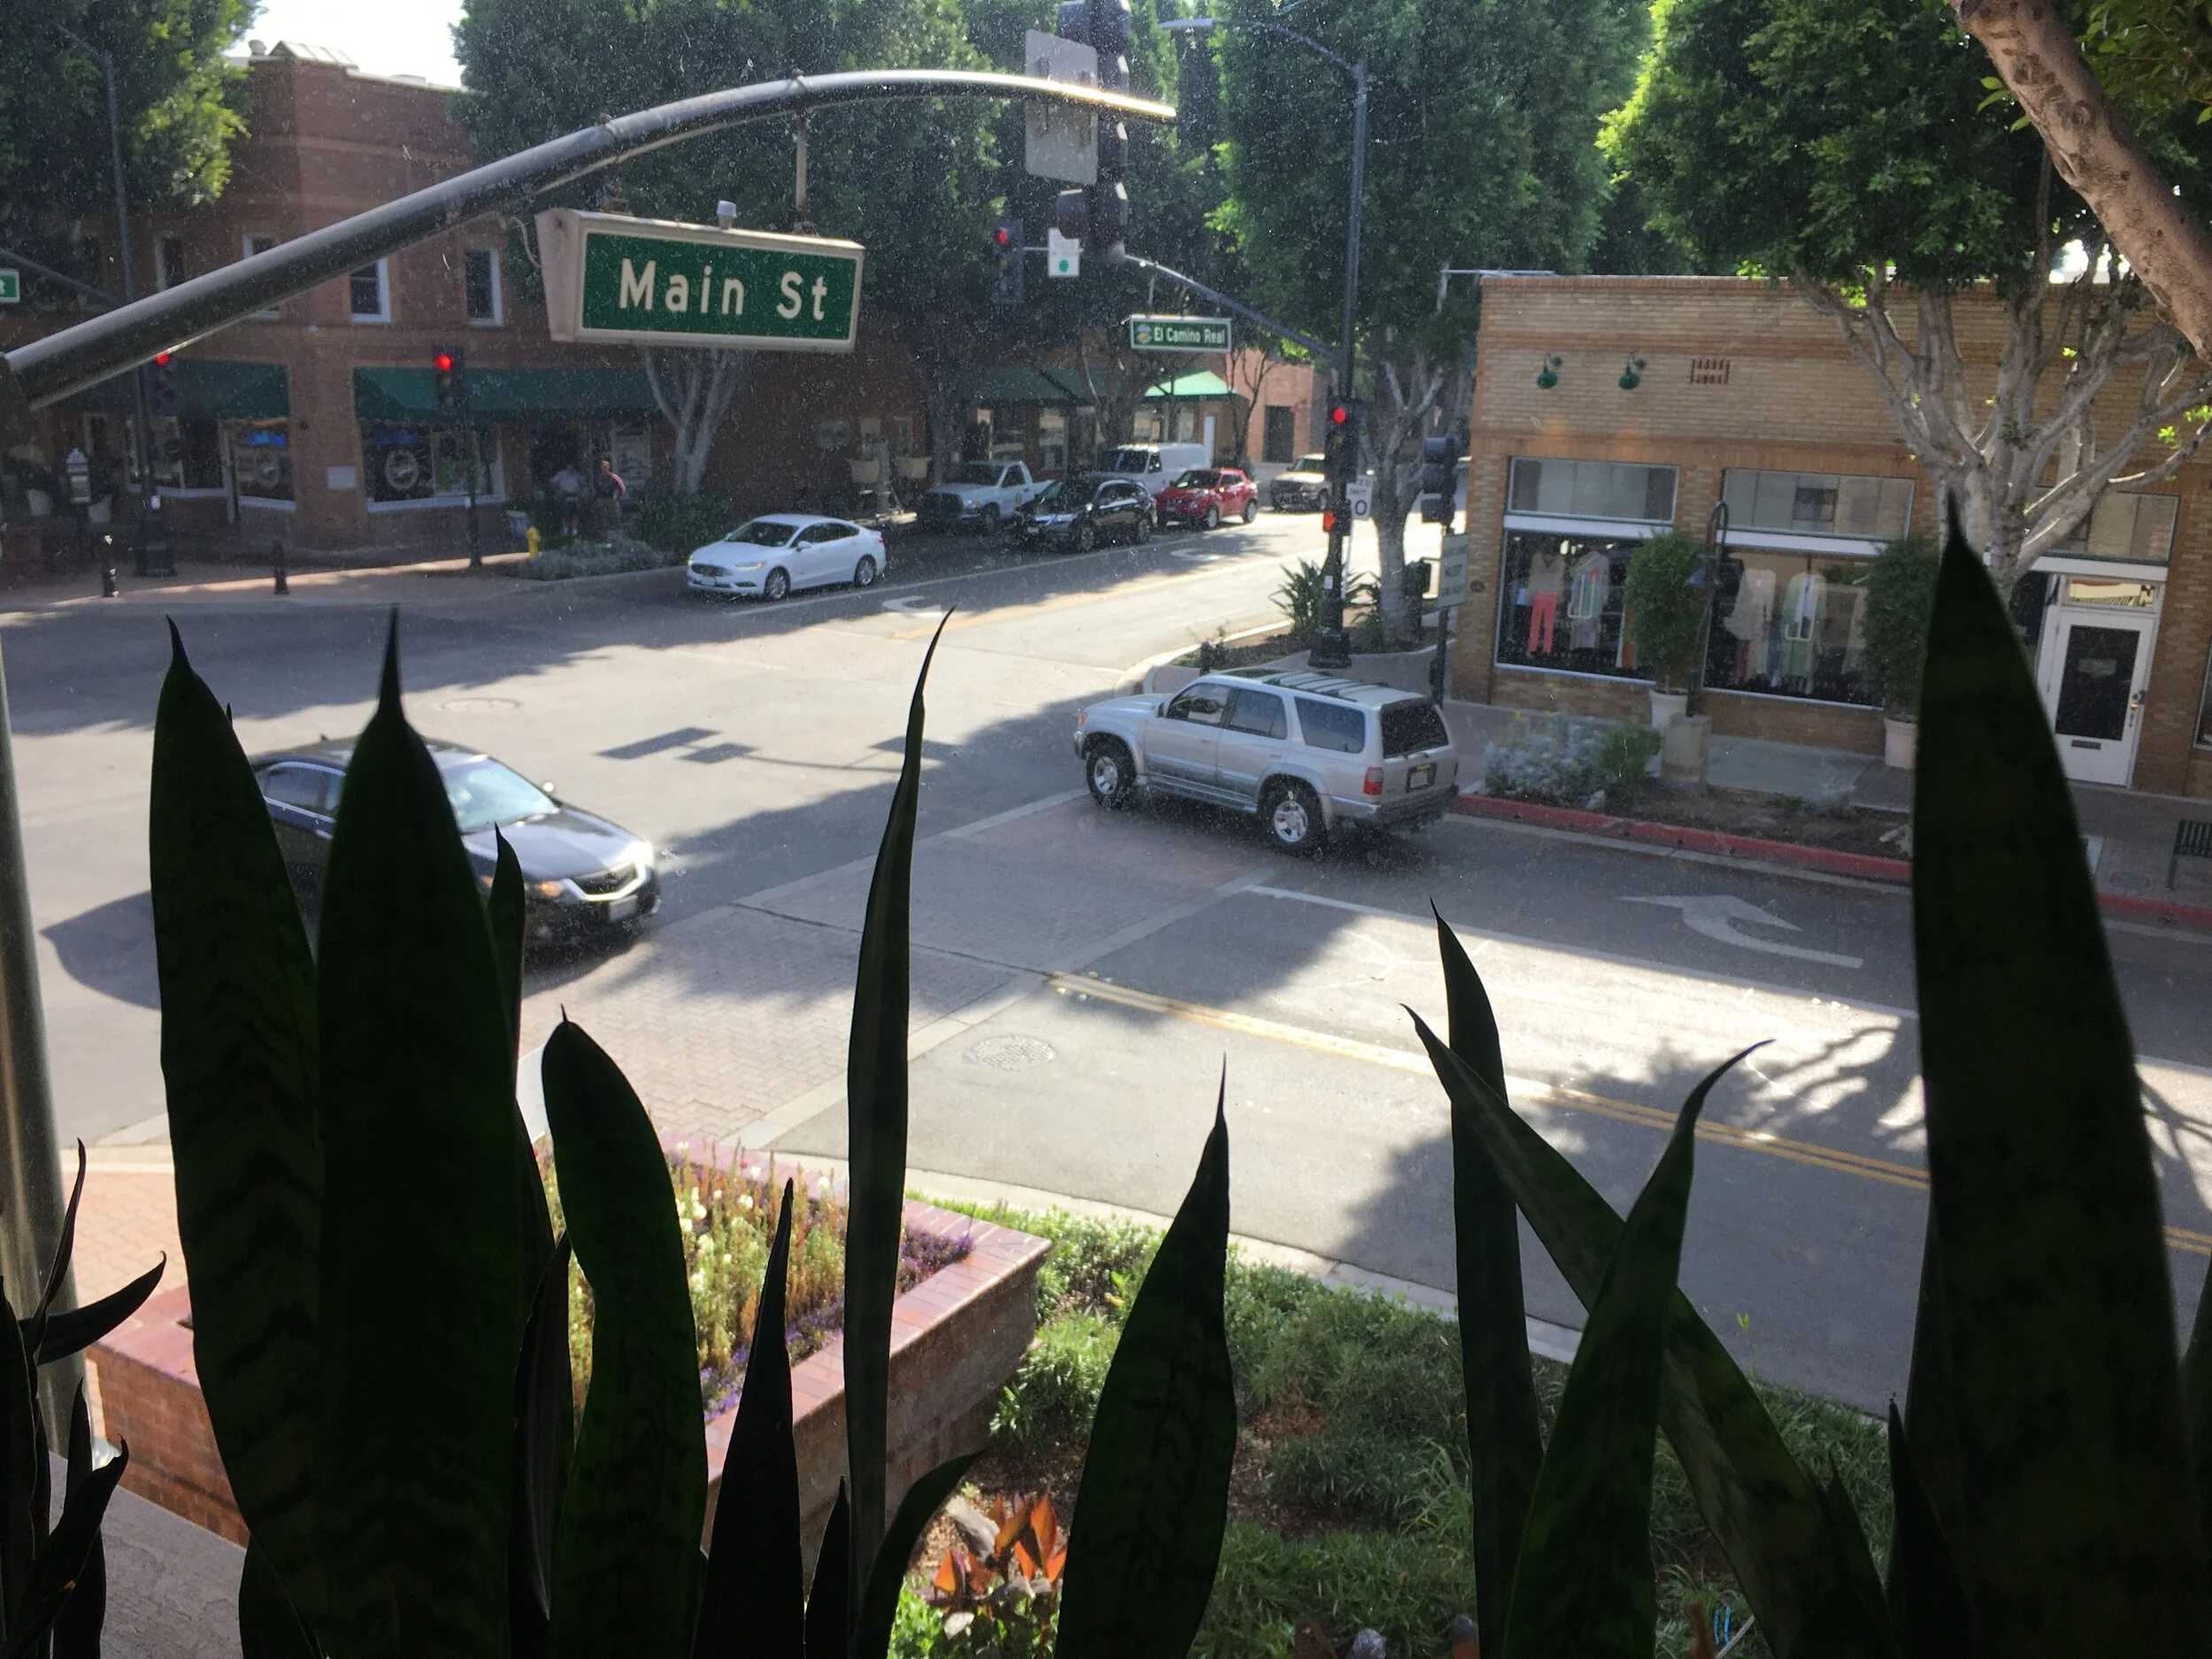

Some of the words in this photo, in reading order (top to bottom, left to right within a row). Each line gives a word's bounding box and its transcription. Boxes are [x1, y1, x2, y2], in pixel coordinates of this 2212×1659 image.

[619, 258, 745, 315] Main
[776, 271, 828, 320] St
[1154, 326, 1164, 342] El
[1166, 326, 1201, 342] Camino
[1204, 328, 1225, 343] Real
